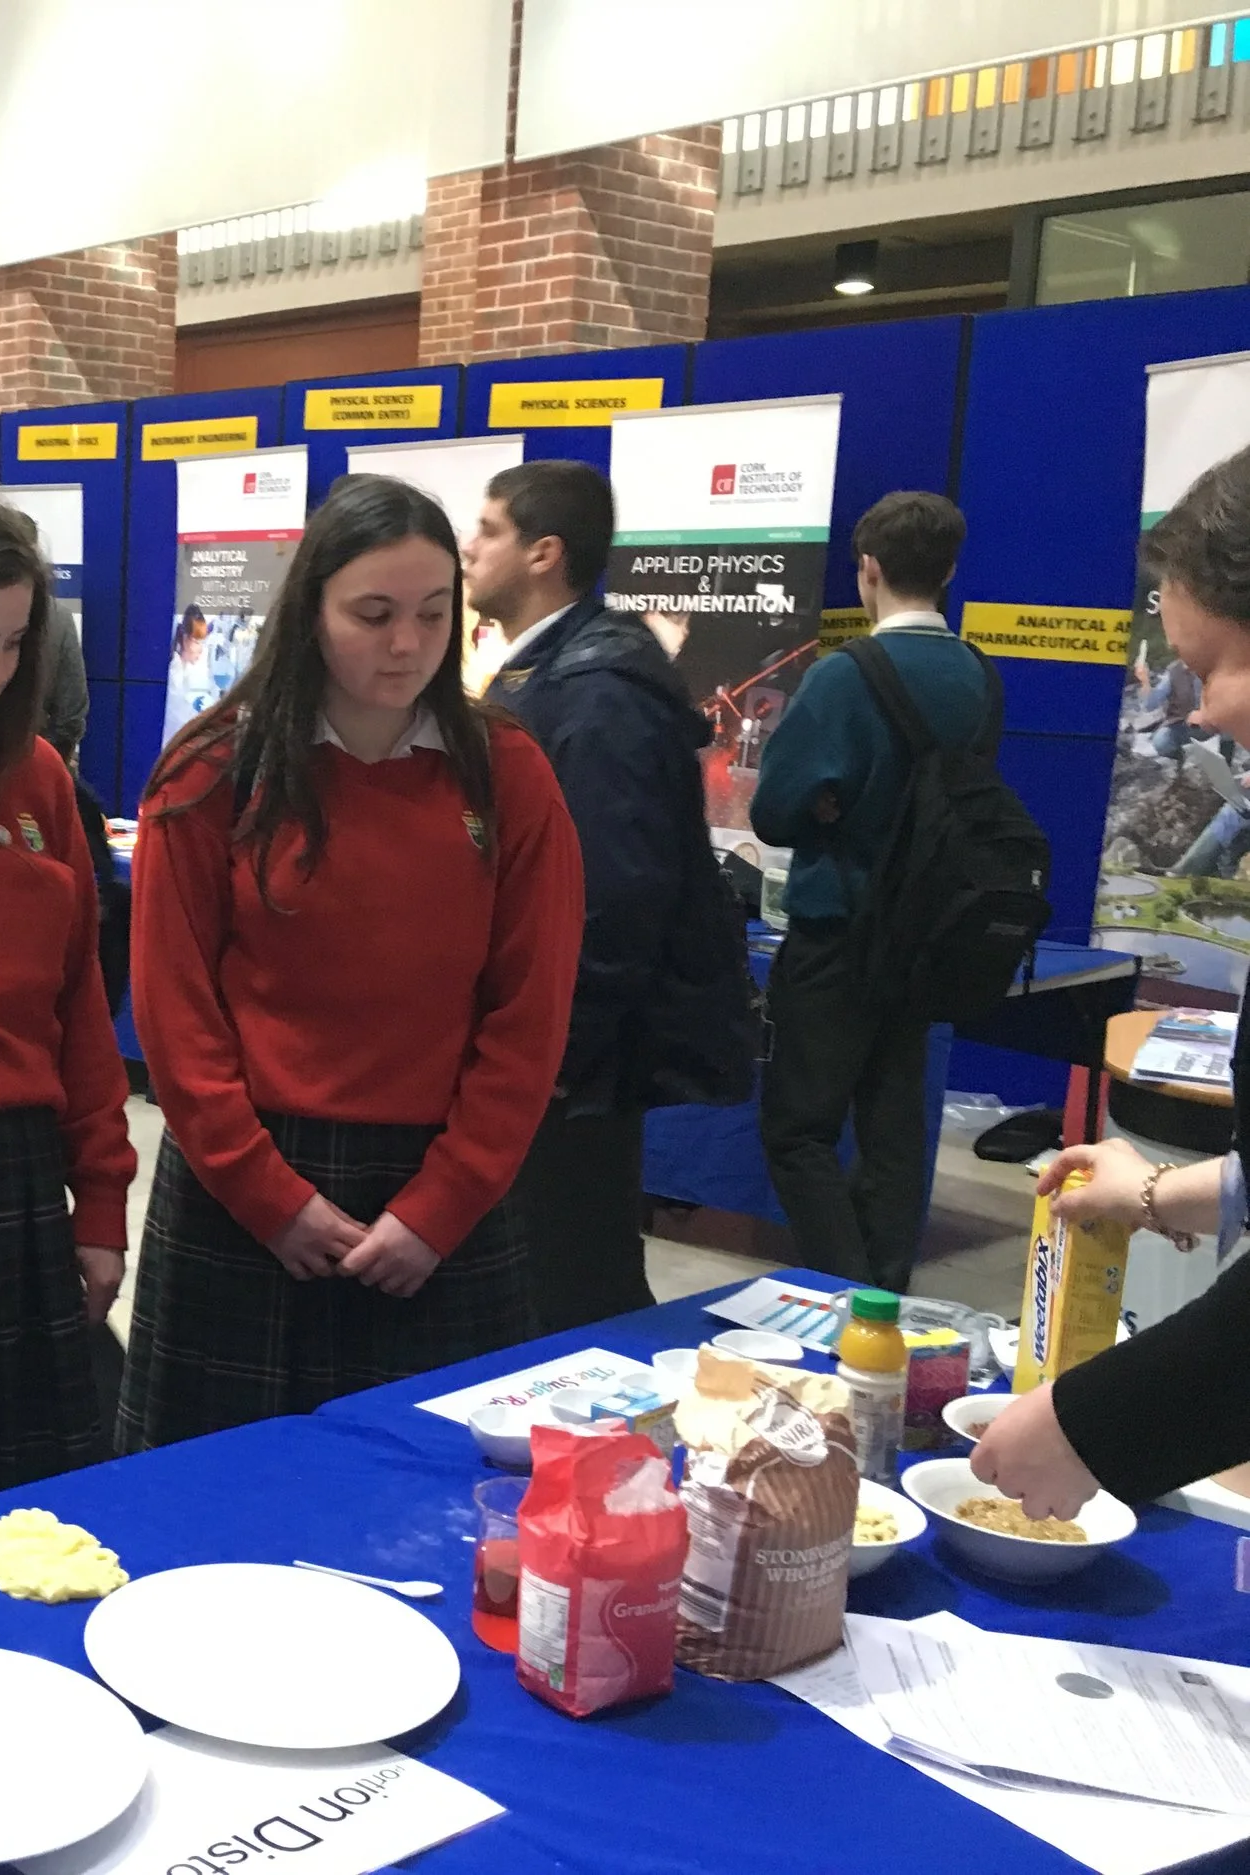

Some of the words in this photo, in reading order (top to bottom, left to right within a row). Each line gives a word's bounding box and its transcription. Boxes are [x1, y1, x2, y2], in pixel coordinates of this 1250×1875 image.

[330, 395, 369, 406] PHYSICAL
[373, 394, 414, 405] SCIENCES
[521, 399, 570, 410] PHYSICAL
[574, 398, 627, 409] SCIENCES
[740, 463, 767, 473] CORK
[739, 472, 786, 484] INSTITUTE
[788, 471, 802, 482] OF
[739, 482, 804, 495] TECHNOLOGY
[191, 550, 249, 563] ANALYTICAL
[189, 565, 245, 578] CHEMISTRY
[631, 555, 704, 575] APPLIED
[707, 554, 786, 574] PHYSICS
[201, 580, 228, 592] WITH
[229, 580, 271, 593] QUALITY
[698, 574, 712, 594] &
[618, 594, 796, 614] INSTRUMENTATION
[1015, 615, 1107, 633] ANALYTICAL
[966, 631, 1101, 652] PHARMACEUTICAL
[1033, 1233, 1050, 1364] Weetabix
[575, 1366, 617, 1382] The
[528, 1375, 580, 1400] Sugar
